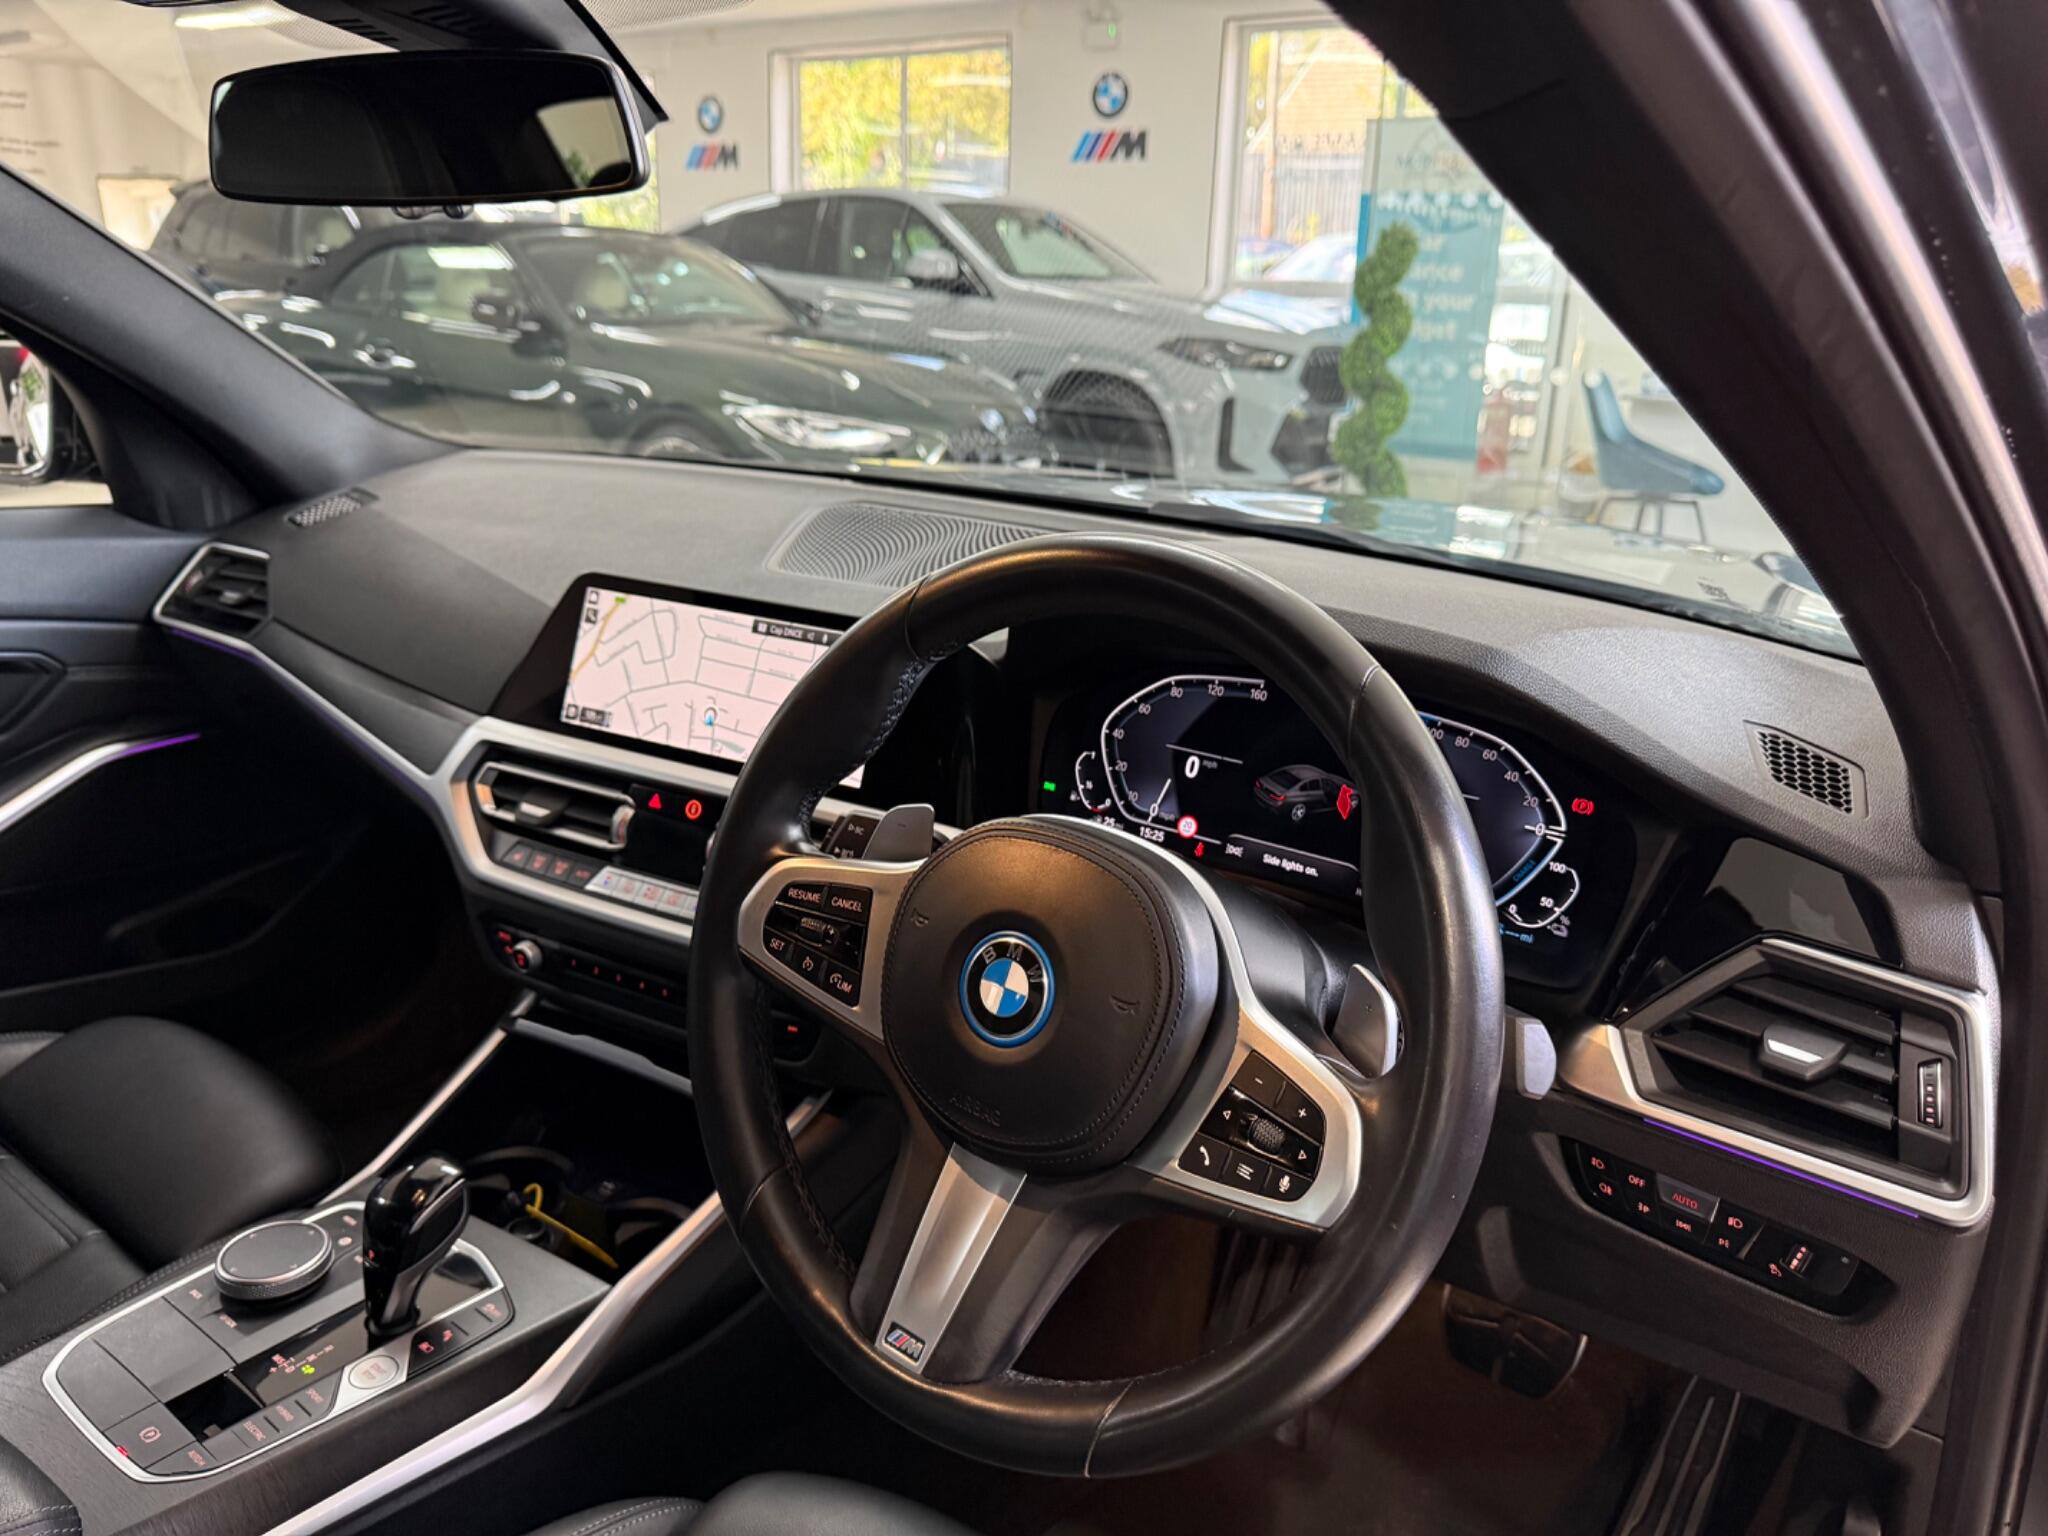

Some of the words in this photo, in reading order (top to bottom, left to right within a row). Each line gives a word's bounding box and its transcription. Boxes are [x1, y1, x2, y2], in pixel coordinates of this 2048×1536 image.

[1169, 685, 1184, 698] 80
[1207, 684, 1225, 697] 120
[1249, 688, 1268, 701] 160
[1137, 702, 1151, 715] 60
[1111, 727, 1125, 740] 40
[1428, 727, 1444, 740] 00
[1454, 735, 1470, 749] 80
[1482, 748, 1498, 762] 60
[1114, 760, 1128, 773] 20
[1184, 754, 1200, 779] 0
[1503, 770, 1520, 783] 40
[1127, 790, 1139, 802] 10
[1522, 794, 1539, 808] 20
[1149, 803, 1159, 818] 0
[1139, 826, 1165, 843] 15:25
[1535, 823, 1546, 836] 0
[1262, 853, 1280, 867] Side
[1281, 858, 1305, 873] lights
[1304, 866, 1319, 878] on.
[1549, 861, 1567, 874] 100
[787, 887, 821, 904] RESUME
[831, 896, 863, 913] CANCEL
[1508, 904, 1517, 914] 0
[1539, 896, 1554, 909] 50
[769, 938, 785, 951] SET
[982, 942, 1043, 983] BMW
[1628, 1174, 1646, 1188] OFF
[1671, 1192, 1699, 1210] AUTO
